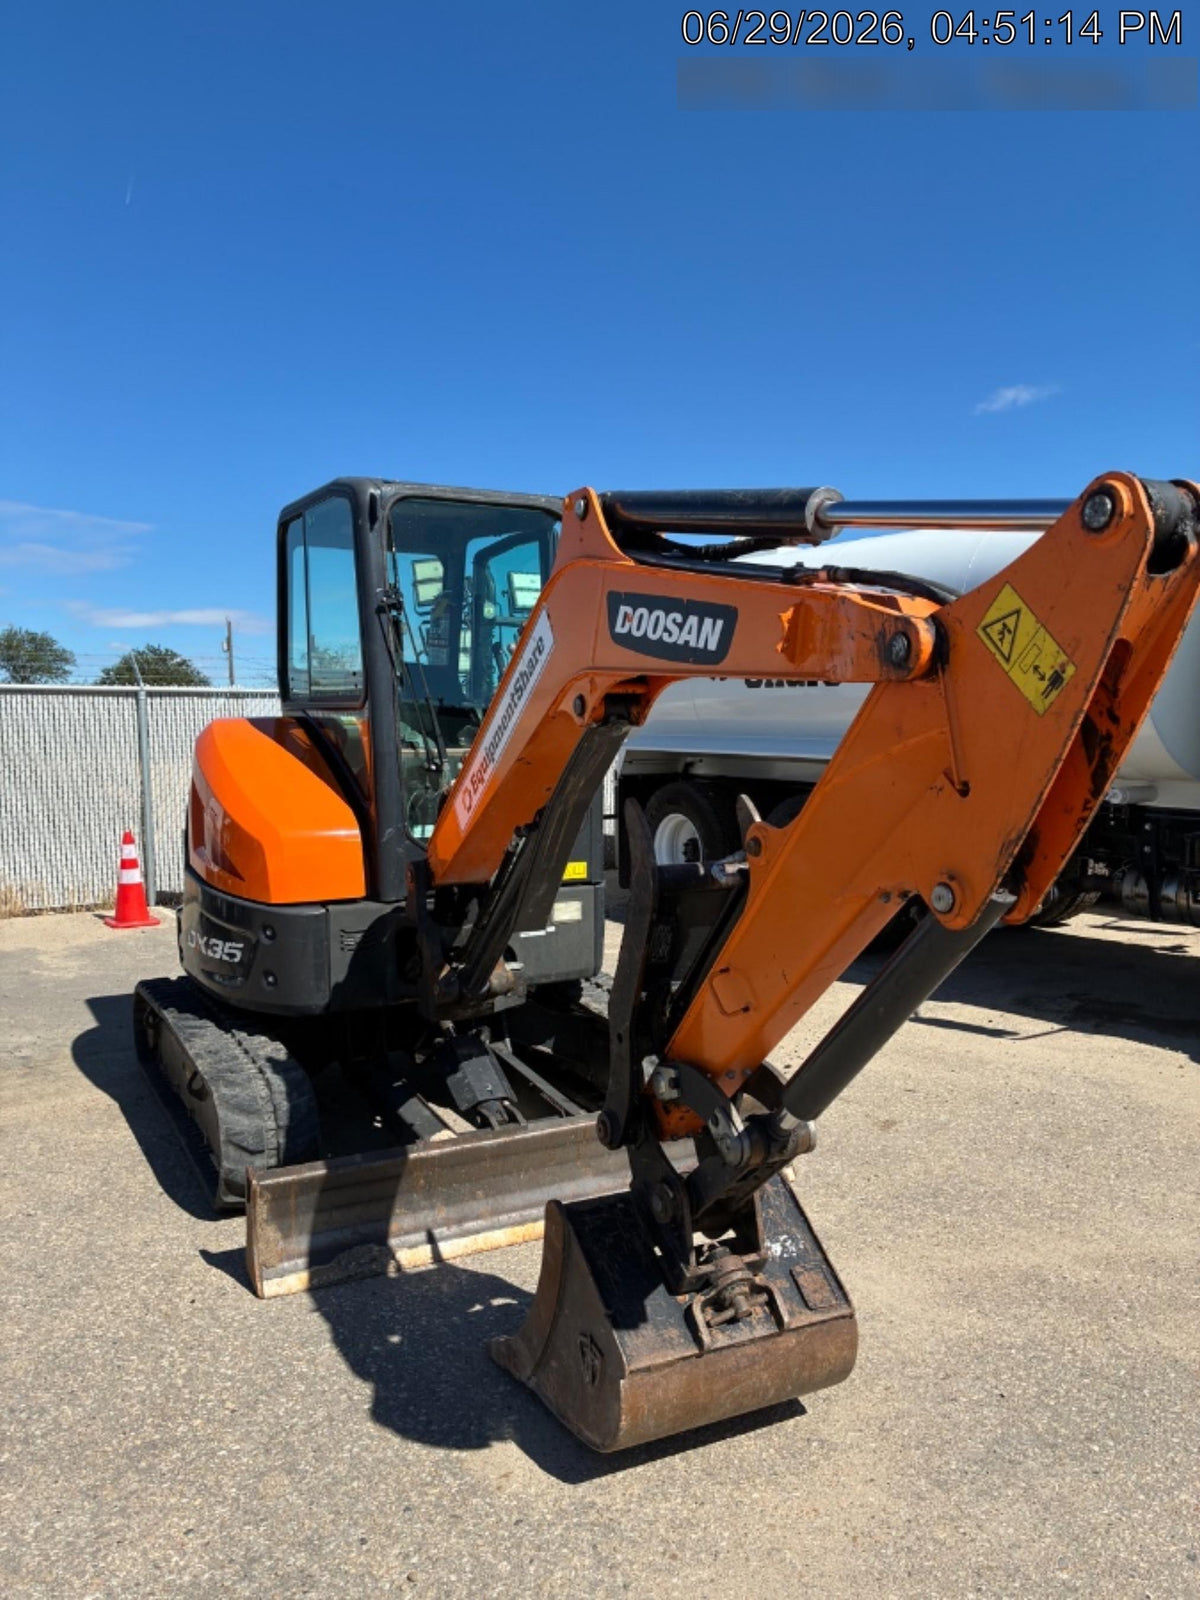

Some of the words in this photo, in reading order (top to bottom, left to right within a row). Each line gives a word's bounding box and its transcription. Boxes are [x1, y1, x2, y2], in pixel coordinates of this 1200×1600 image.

[614, 605, 723, 651] DOOSAN
[470, 635, 545, 790] EquipmentShare
[188, 930, 244, 963] DX35
